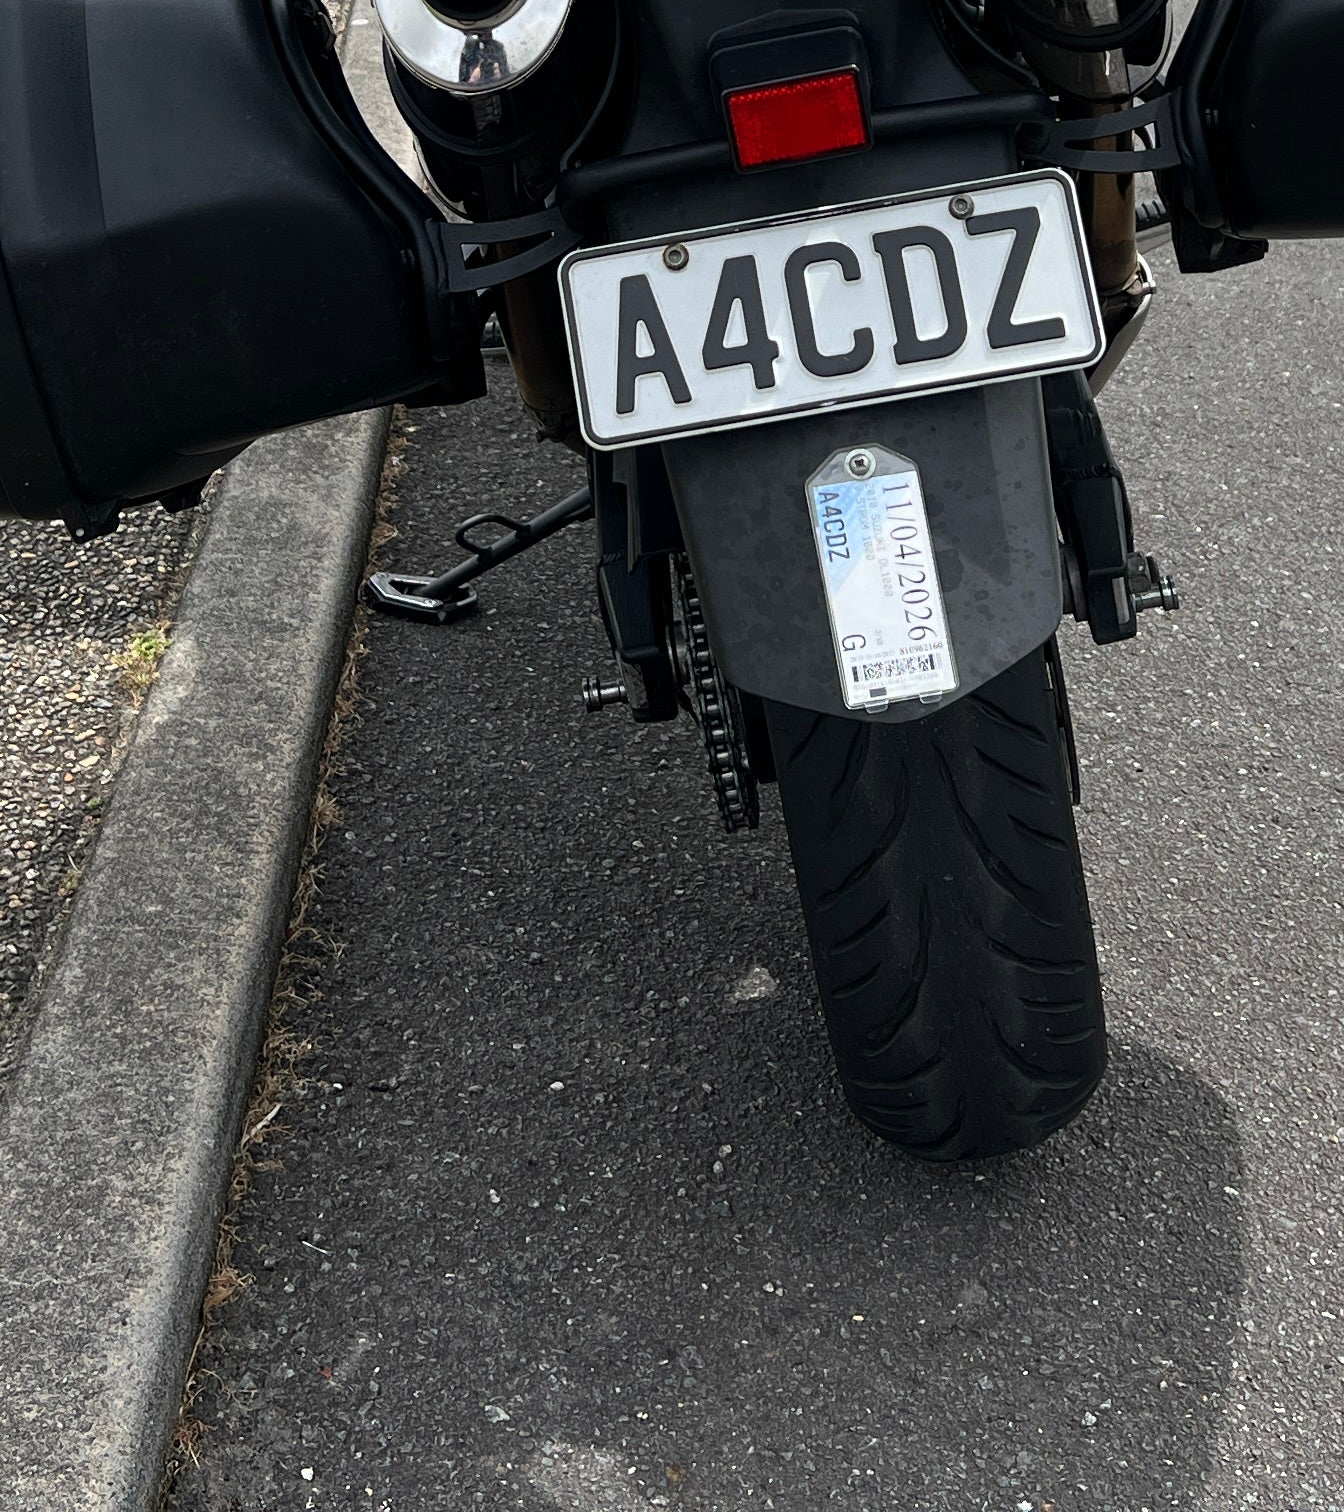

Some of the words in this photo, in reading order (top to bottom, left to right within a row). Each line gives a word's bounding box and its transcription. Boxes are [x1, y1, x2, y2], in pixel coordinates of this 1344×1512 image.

[614, 205, 1067, 416] A4CDZ
[818, 491, 850, 563] A4CDZ
[882, 482, 937, 641] 11/04/2026
[841, 633, 867, 652] G
